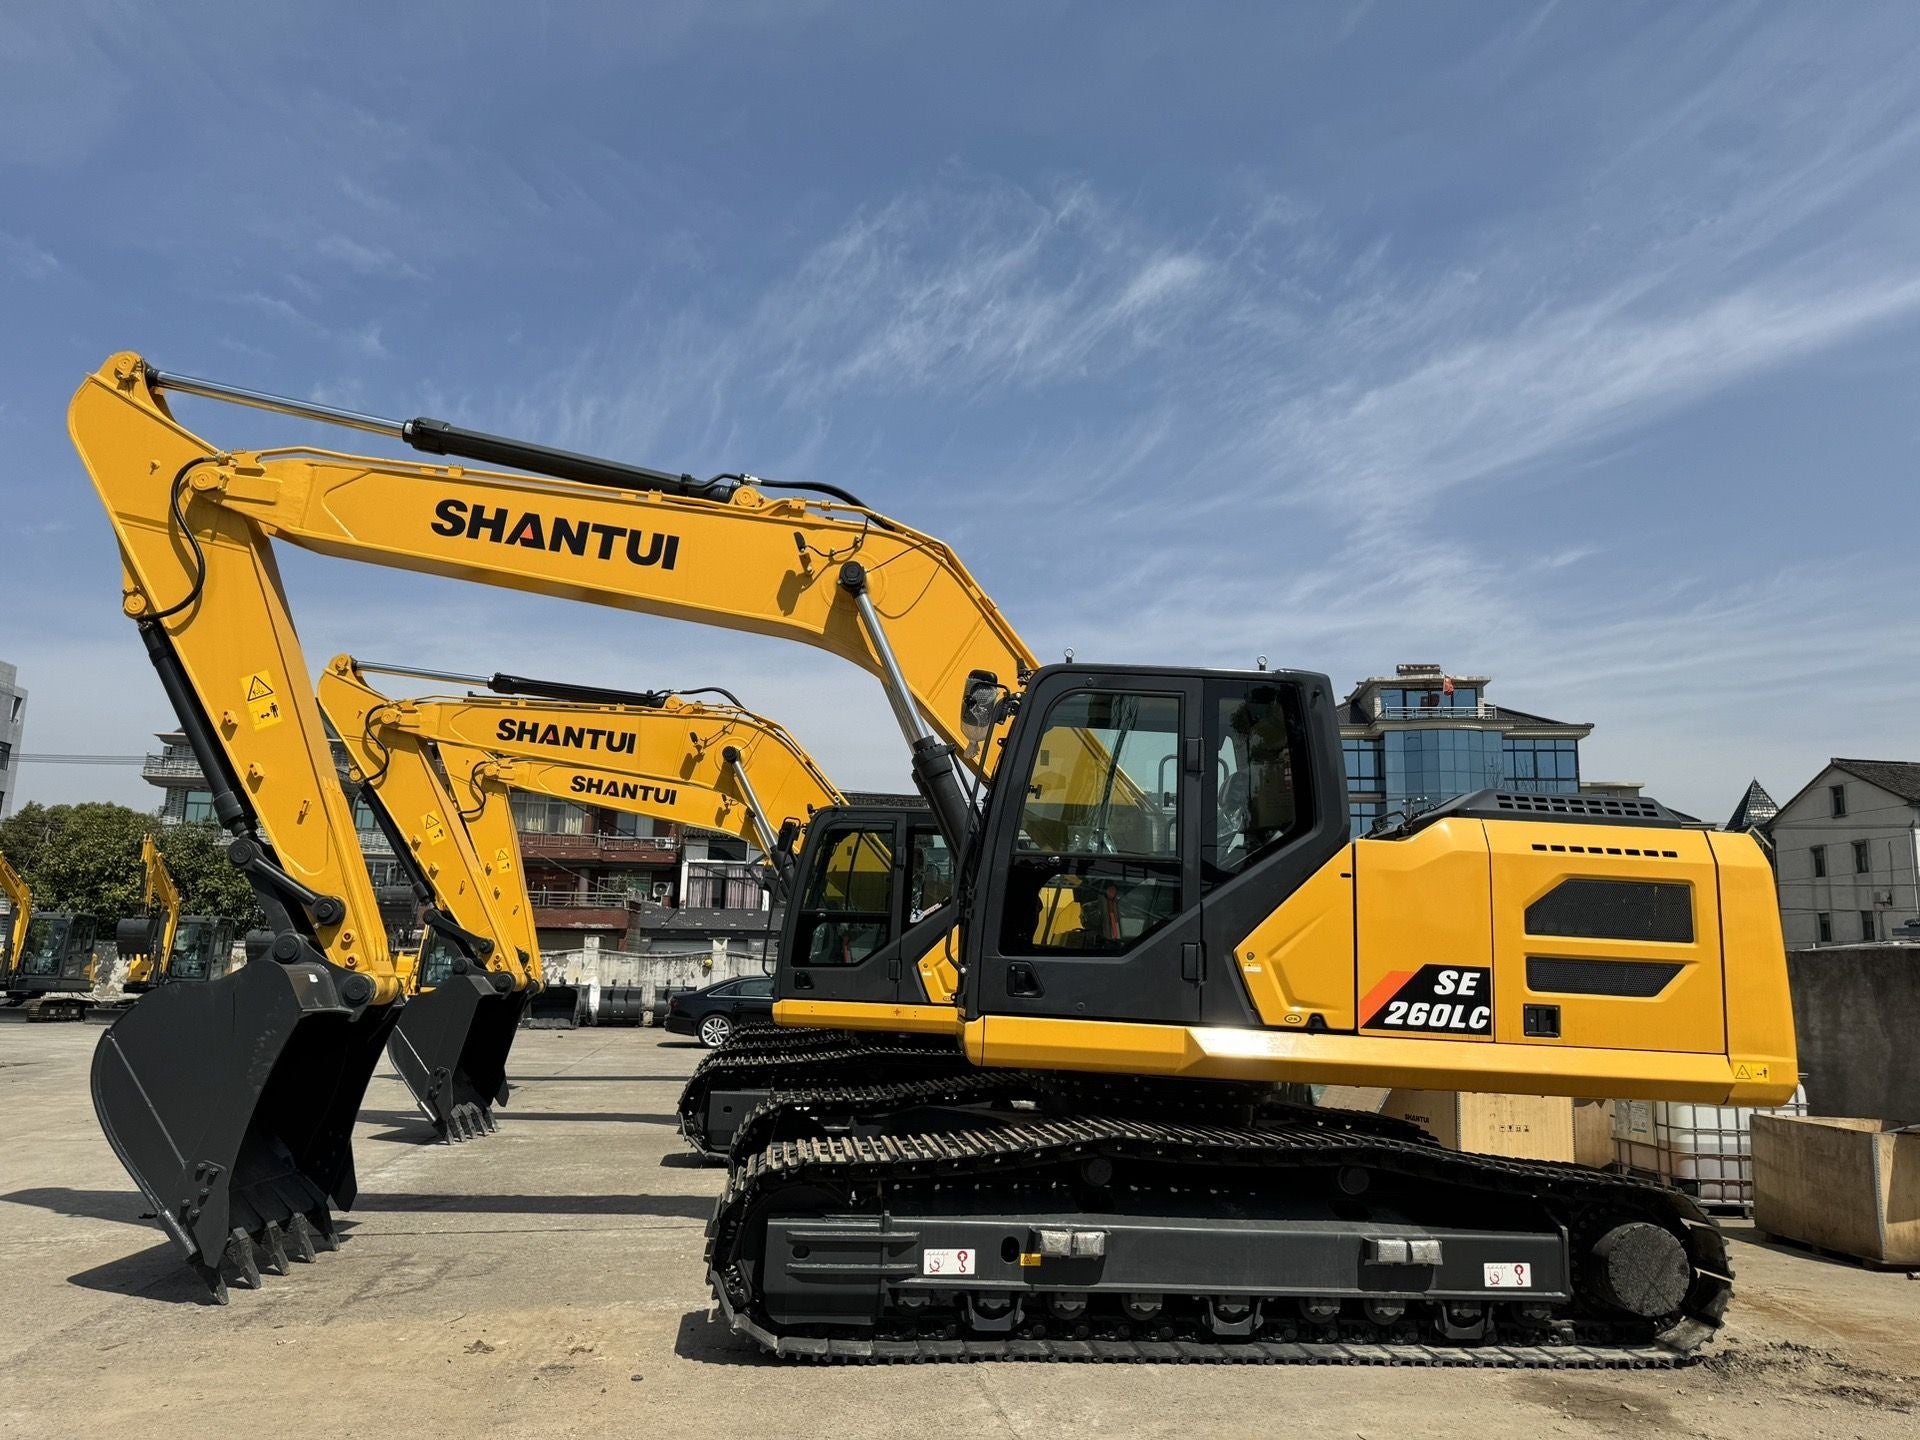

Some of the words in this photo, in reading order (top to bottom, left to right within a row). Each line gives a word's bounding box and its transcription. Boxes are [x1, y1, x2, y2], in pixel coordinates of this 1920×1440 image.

[430, 499, 680, 571] SHANTUI
[496, 718, 637, 755] SHANTUI
[570, 775, 678, 806] SHANTUI
[1433, 969, 1481, 996] SE
[1383, 1001, 1491, 1029] 260LC
